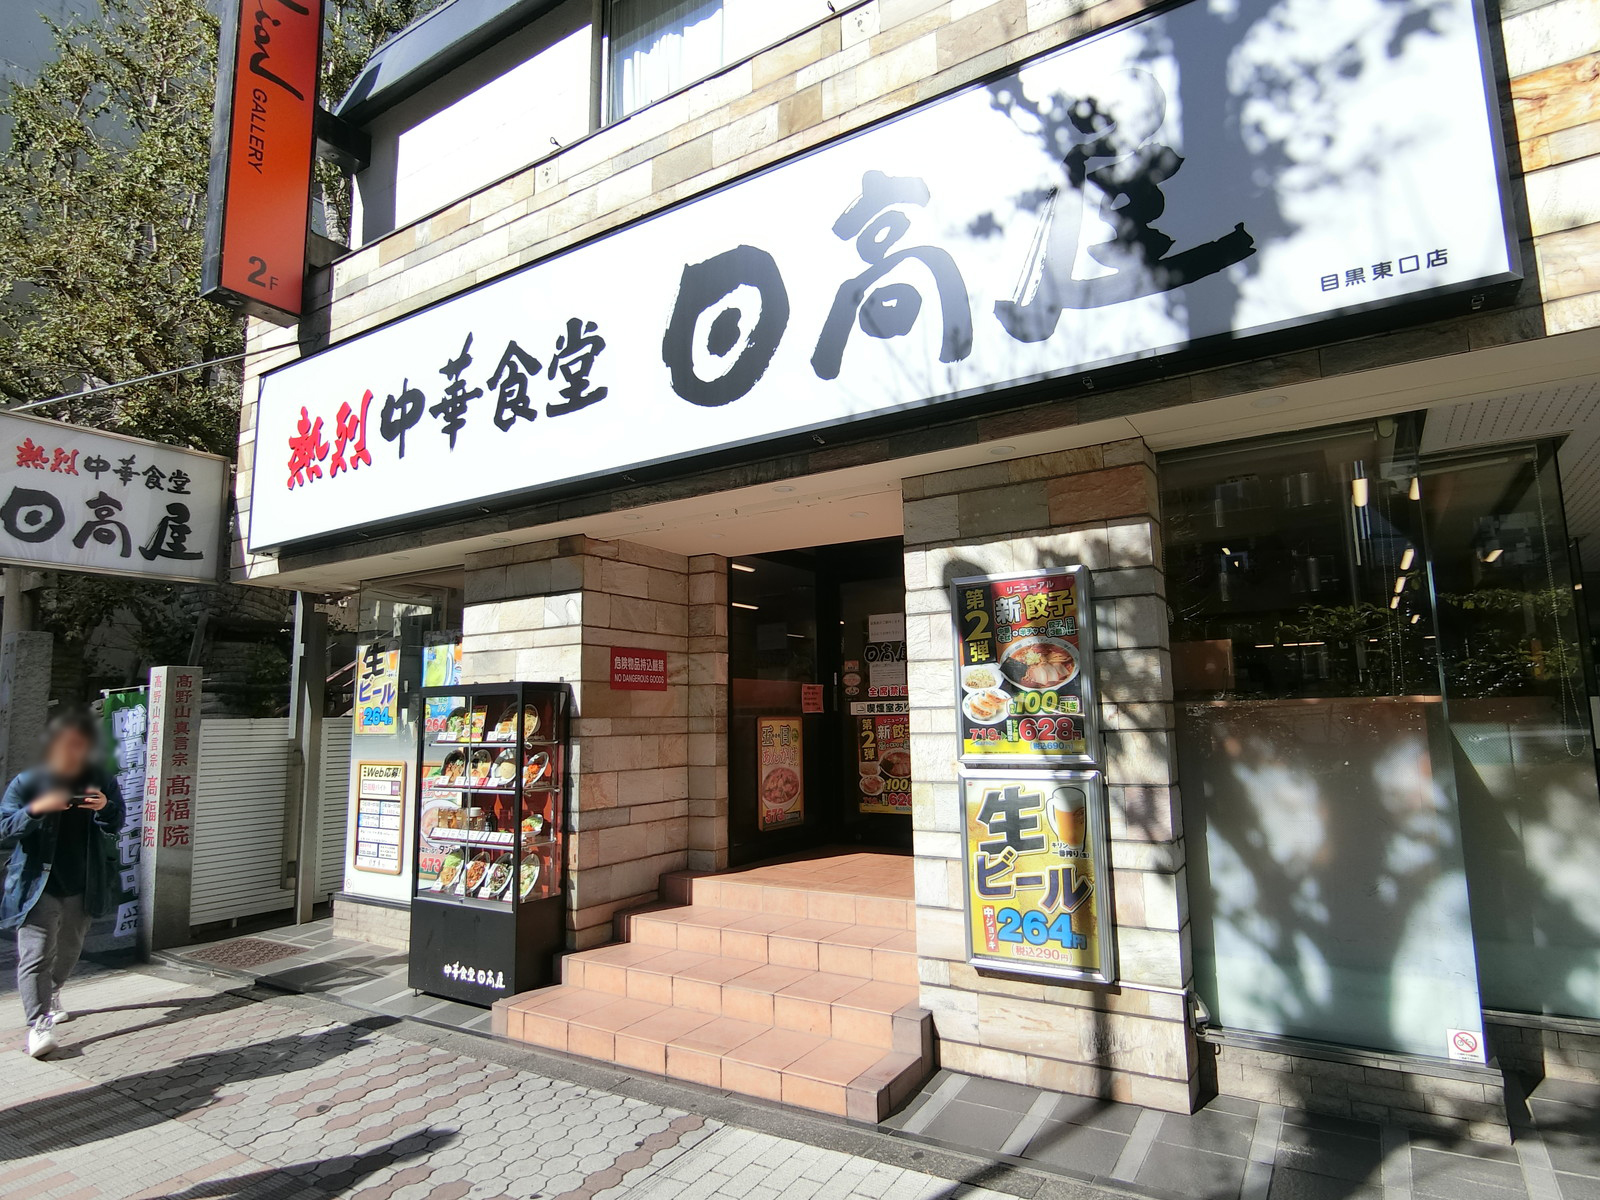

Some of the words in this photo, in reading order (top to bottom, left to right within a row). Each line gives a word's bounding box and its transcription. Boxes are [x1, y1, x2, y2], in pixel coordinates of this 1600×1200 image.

[248, 88, 267, 174] GALLERY
[247, 255, 279, 291] 2F
[287, 317, 608, 490] 熱烈中華食堂
[661, 66, 1257, 408] 日高屋
[1320, 248, 1449, 292] 目黒東口店
[16, 437, 192, 495] 熱烈中華食堂
[0, 485, 204, 561] 日高屋
[1006, 580, 1055, 594] リニューアル
[362, 642, 385, 680] 生
[614, 673, 622, 682] NO
[623, 674, 649, 683] DANGEROUS
[649, 675, 665, 684] GOODS
[359, 676, 396, 705] ビール
[977, 786, 1046, 857] 生
[977, 849, 1091, 911] ビール
[982, 906, 998, 951] 中ジョッキ
[997, 907, 1087, 950] 264円
